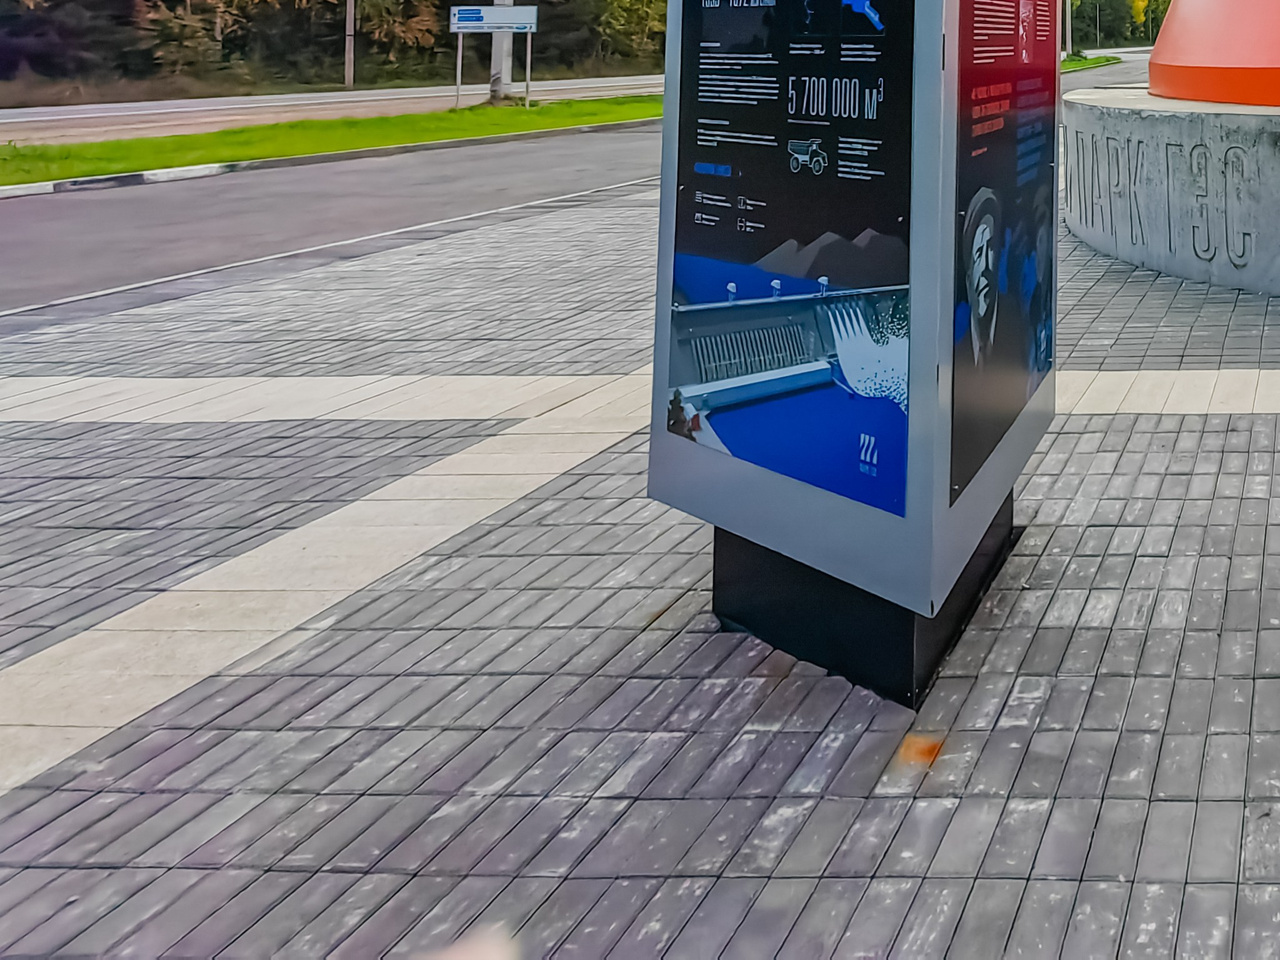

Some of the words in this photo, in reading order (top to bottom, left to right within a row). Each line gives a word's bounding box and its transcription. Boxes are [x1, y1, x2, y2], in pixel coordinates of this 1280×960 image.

[787, 76, 797, 116] 5
[800, 76, 827, 117] 700
[831, 77, 860, 119] 000
[1165, 142, 1254, 270] ГЭС
